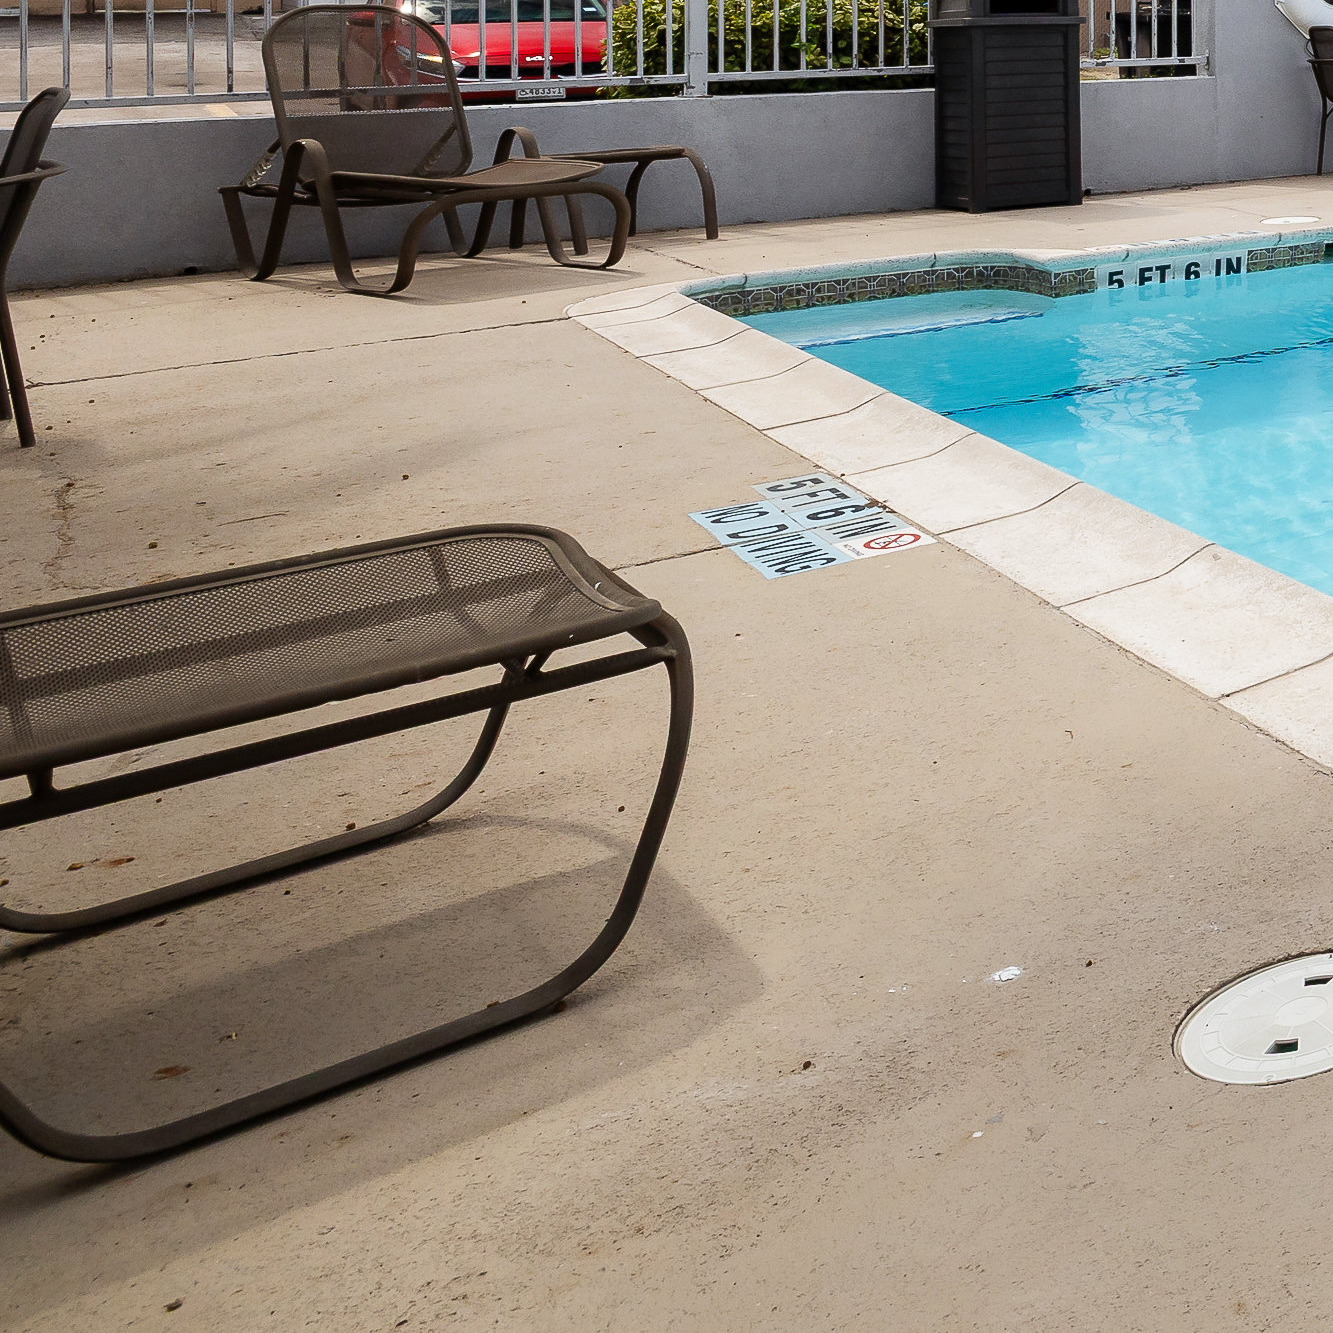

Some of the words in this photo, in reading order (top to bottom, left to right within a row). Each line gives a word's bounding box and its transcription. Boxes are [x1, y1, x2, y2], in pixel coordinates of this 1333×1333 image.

[1107, 269, 1125, 289] 5
[1138, 263, 1172, 286] FT
[1184, 261, 1201, 281] 6
[1214, 256, 1242, 277] IN
[766, 477, 825, 492] 5
[781, 487, 852, 508] FT
[701, 503, 770, 524] NO
[806, 504, 866, 521] 6
[825, 517, 897, 539] IN
[726, 523, 837, 575] DIVING
